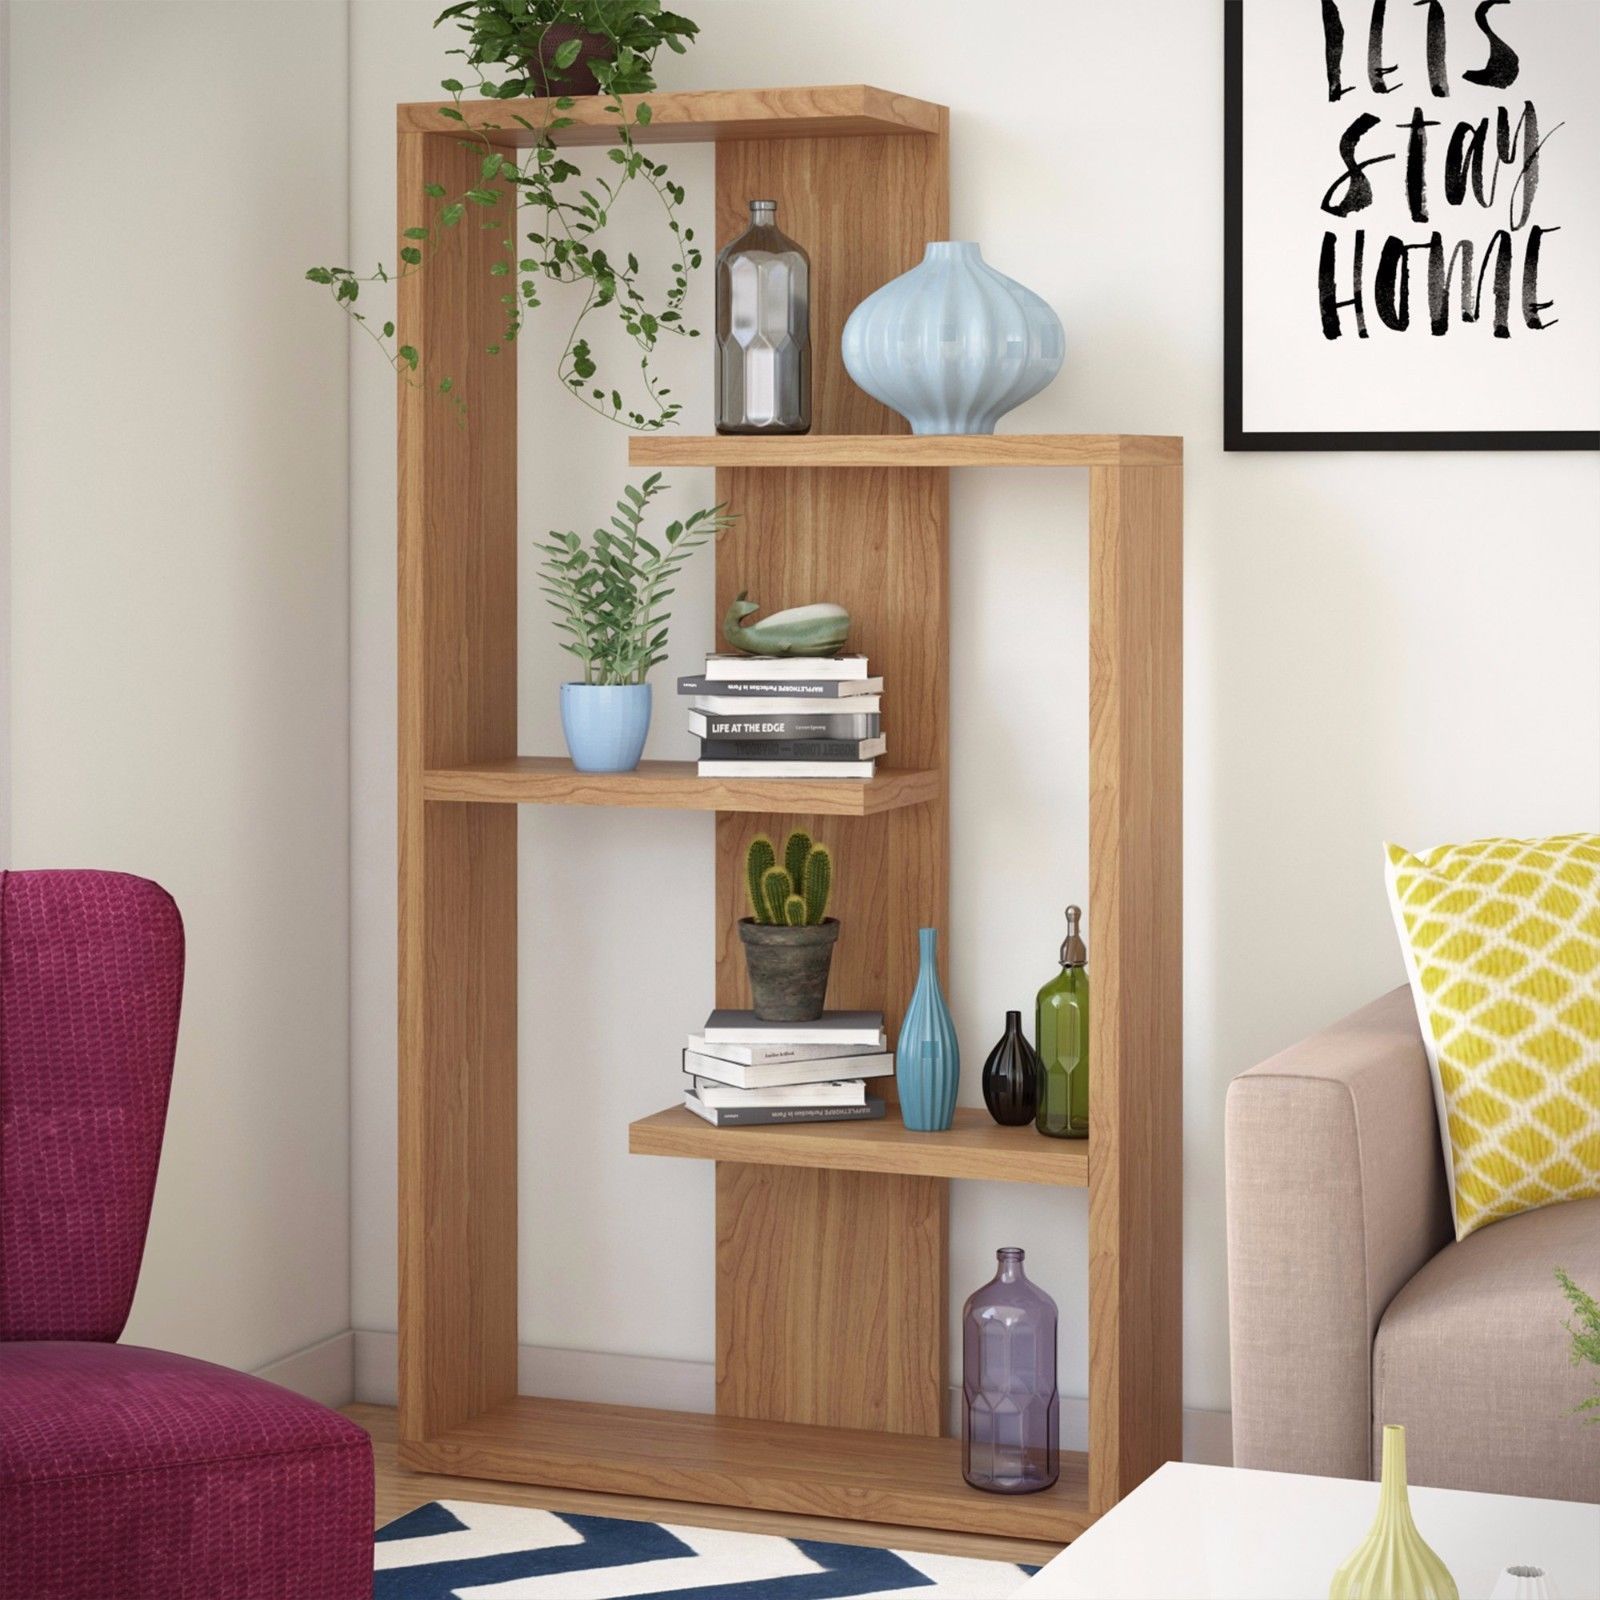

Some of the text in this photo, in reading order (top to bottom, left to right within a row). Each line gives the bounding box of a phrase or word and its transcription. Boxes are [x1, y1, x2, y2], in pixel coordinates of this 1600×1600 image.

[1318, 225, 1561, 340] HOME
[749, 684, 777, 692] Perfection
[712, 723, 730, 733] LIFE
[731, 723, 742, 733] AT
[744, 723, 760, 733] THE
[762, 722, 785, 733] EDGE
[794, 1109, 823, 1117] Perfection
